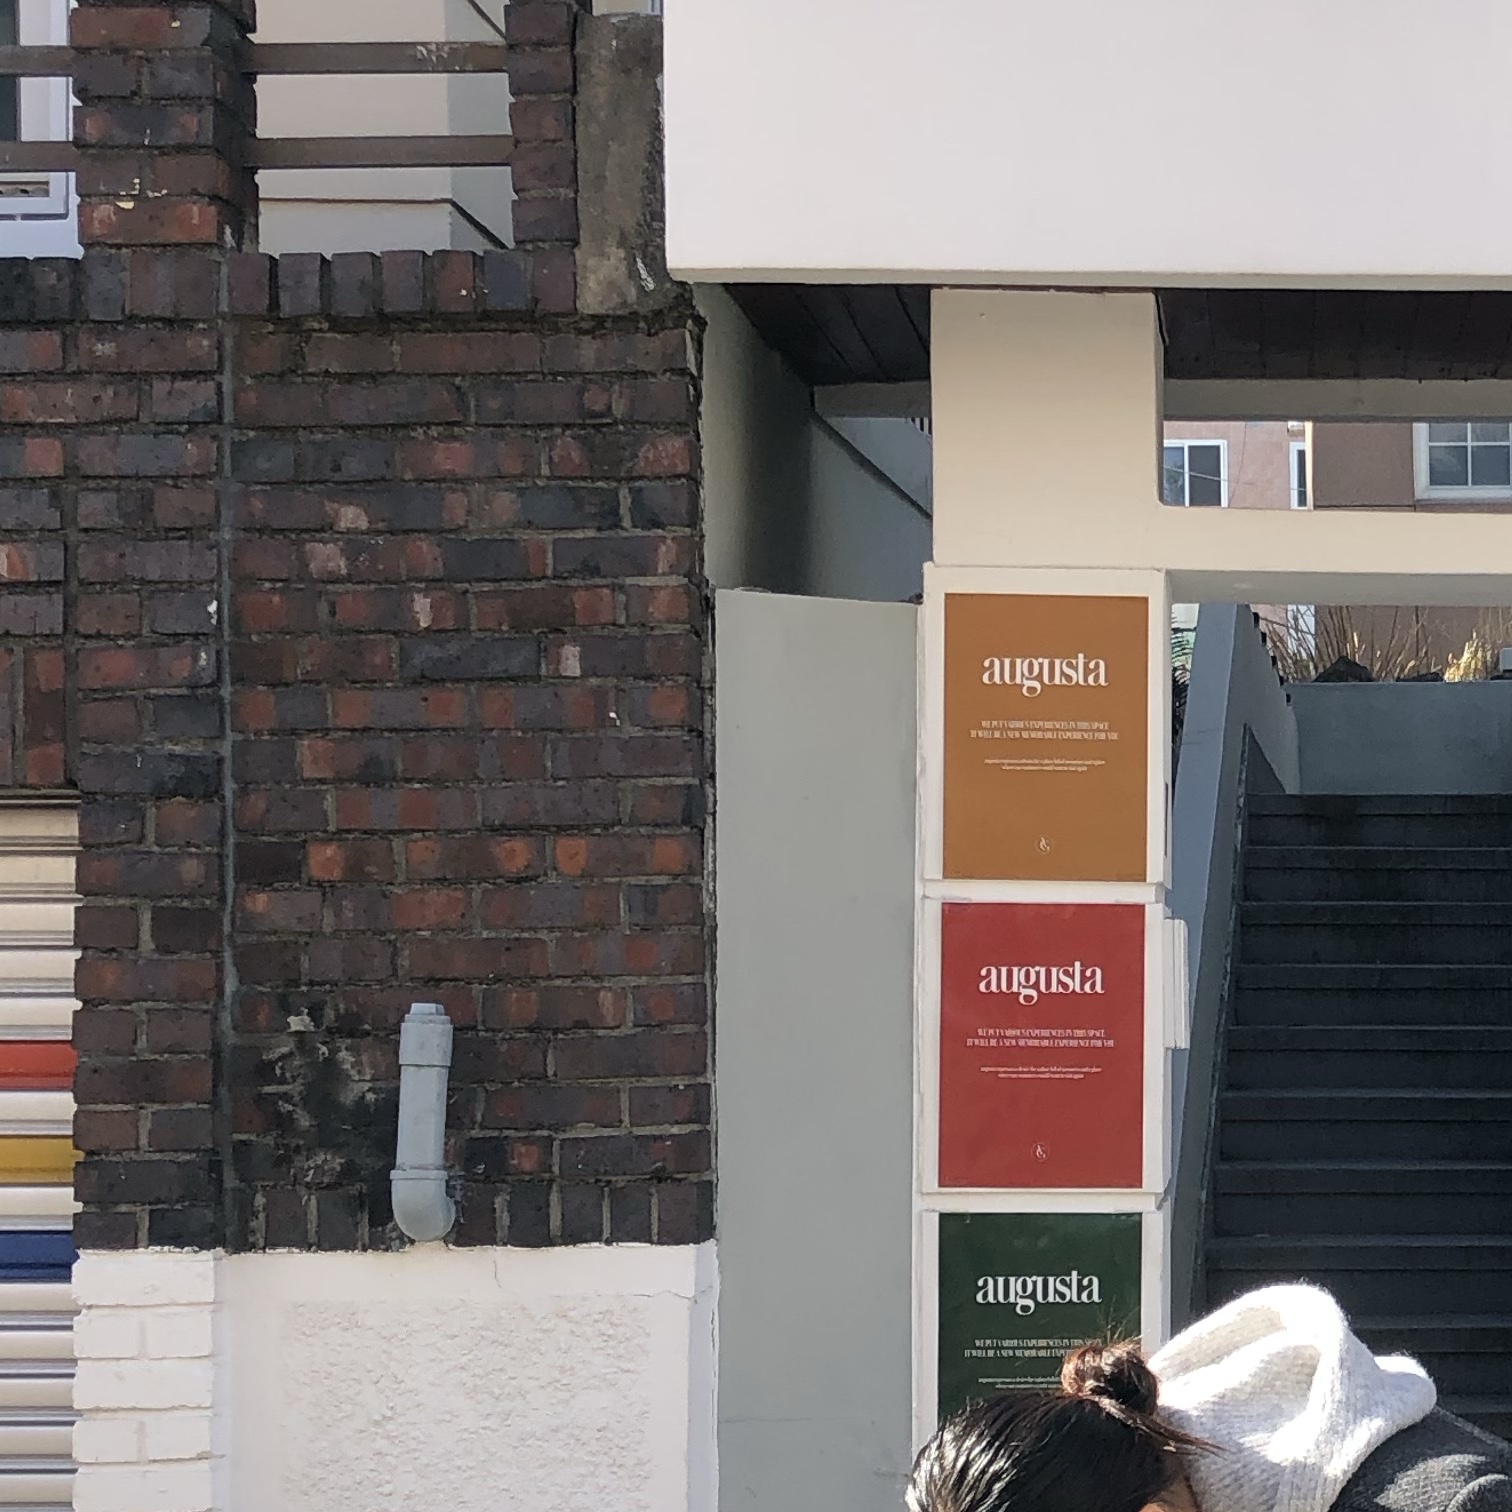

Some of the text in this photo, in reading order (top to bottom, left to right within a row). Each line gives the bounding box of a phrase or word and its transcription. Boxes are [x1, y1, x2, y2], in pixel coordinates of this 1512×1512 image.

[982, 653, 1109, 697] augusta
[978, 961, 1105, 1006] augusta
[975, 1270, 1102, 1316] augusta
